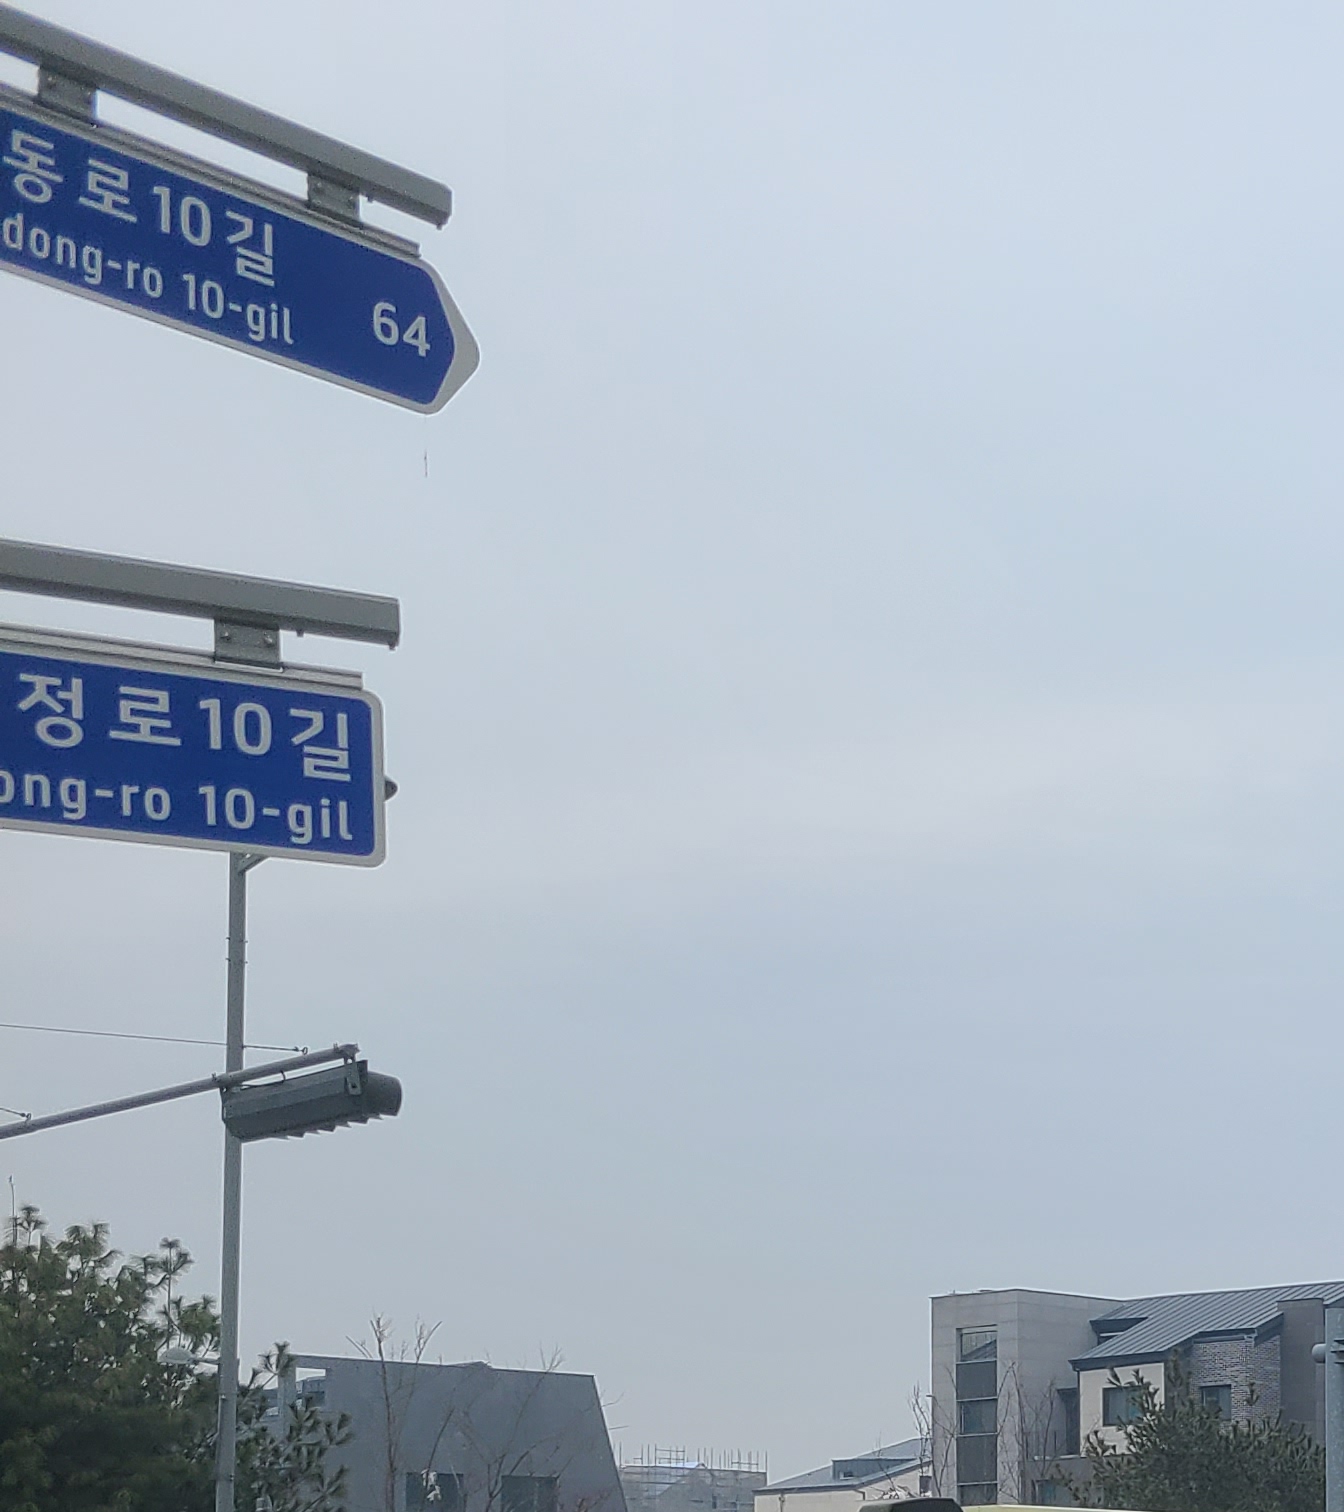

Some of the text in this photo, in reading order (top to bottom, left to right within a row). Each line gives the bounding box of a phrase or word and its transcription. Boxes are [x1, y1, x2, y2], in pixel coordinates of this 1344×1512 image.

[3, 128, 276, 288] 동로10길
[1, 213, 295, 346] dong-ro 10-gil
[371, 300, 432, 359] 64
[17, 672, 352, 783] 정로10길
[198, 784, 353, 845] 10-gil
